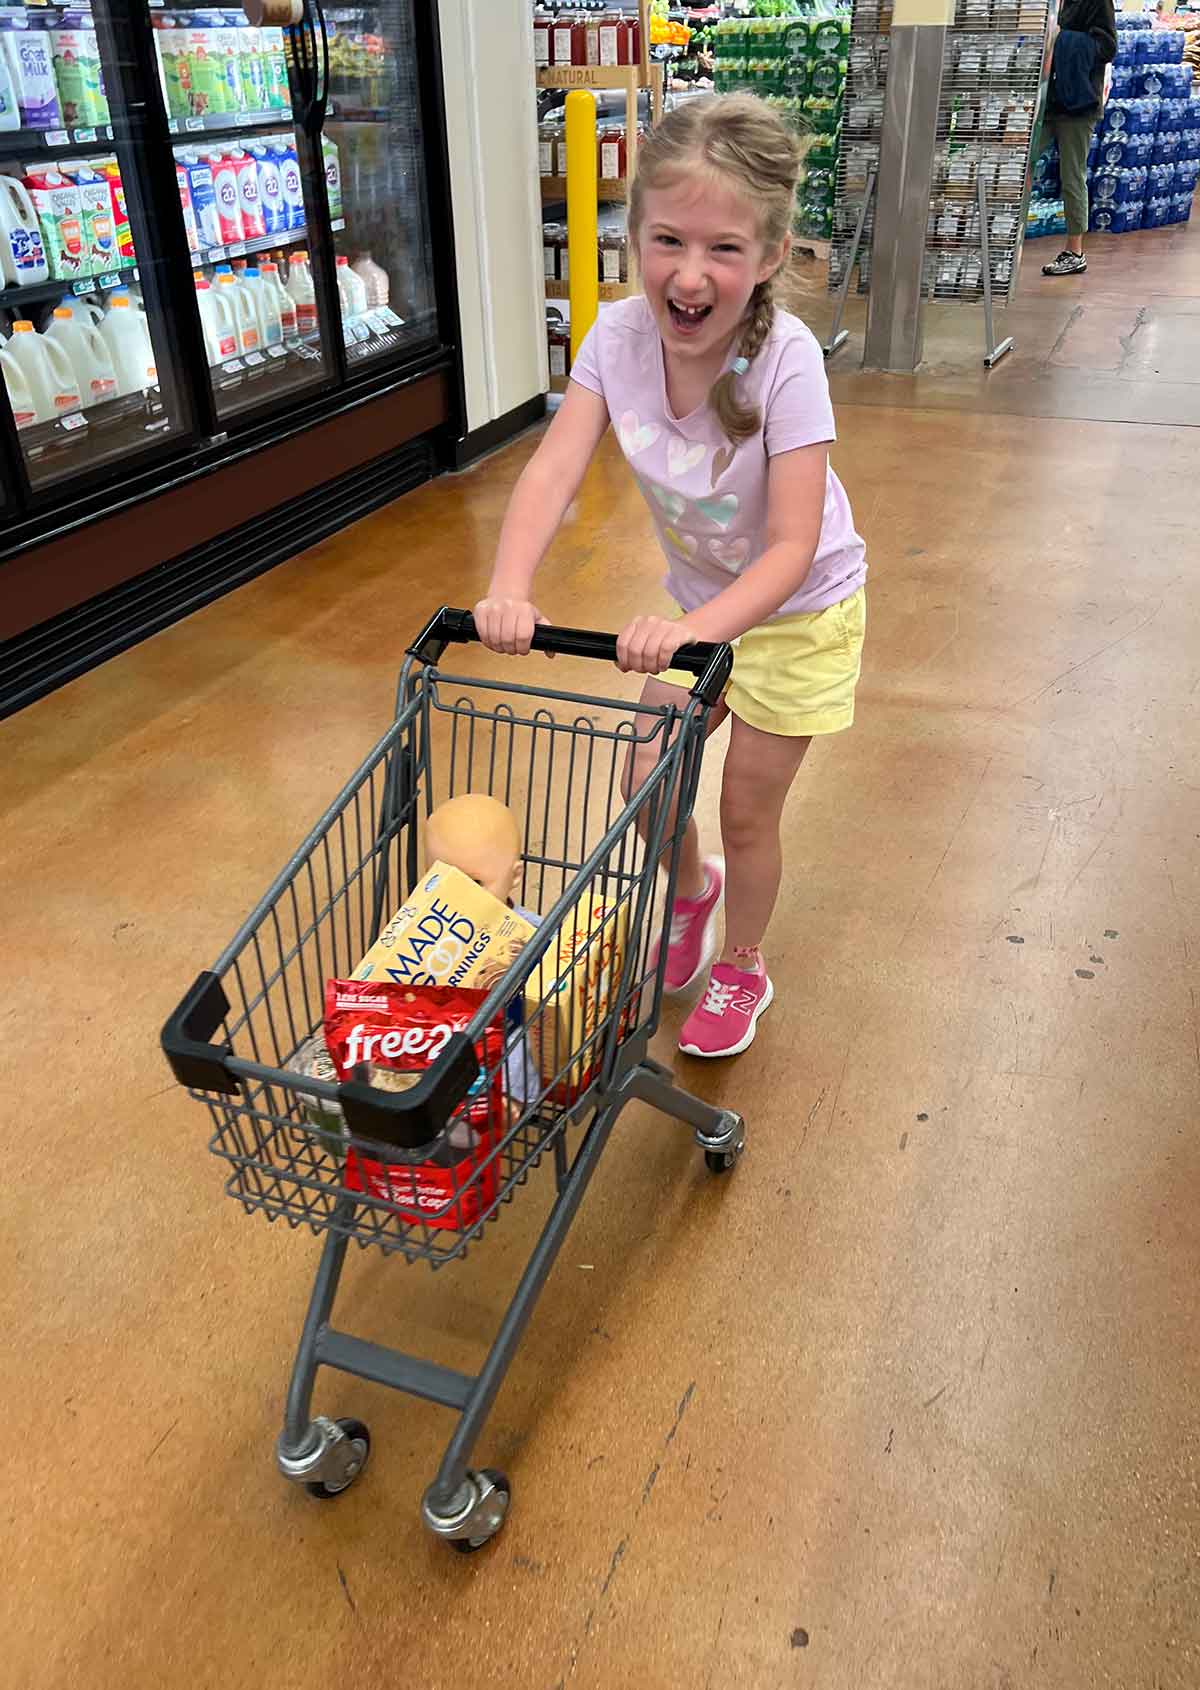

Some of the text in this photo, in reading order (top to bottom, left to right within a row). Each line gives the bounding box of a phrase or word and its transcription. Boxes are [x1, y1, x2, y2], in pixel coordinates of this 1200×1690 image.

[20, 47, 46, 62] Goat
[23, 60, 49, 76] Milk
[546, 69, 598, 85] NATURAL
[386, 898, 457, 985] MADE
